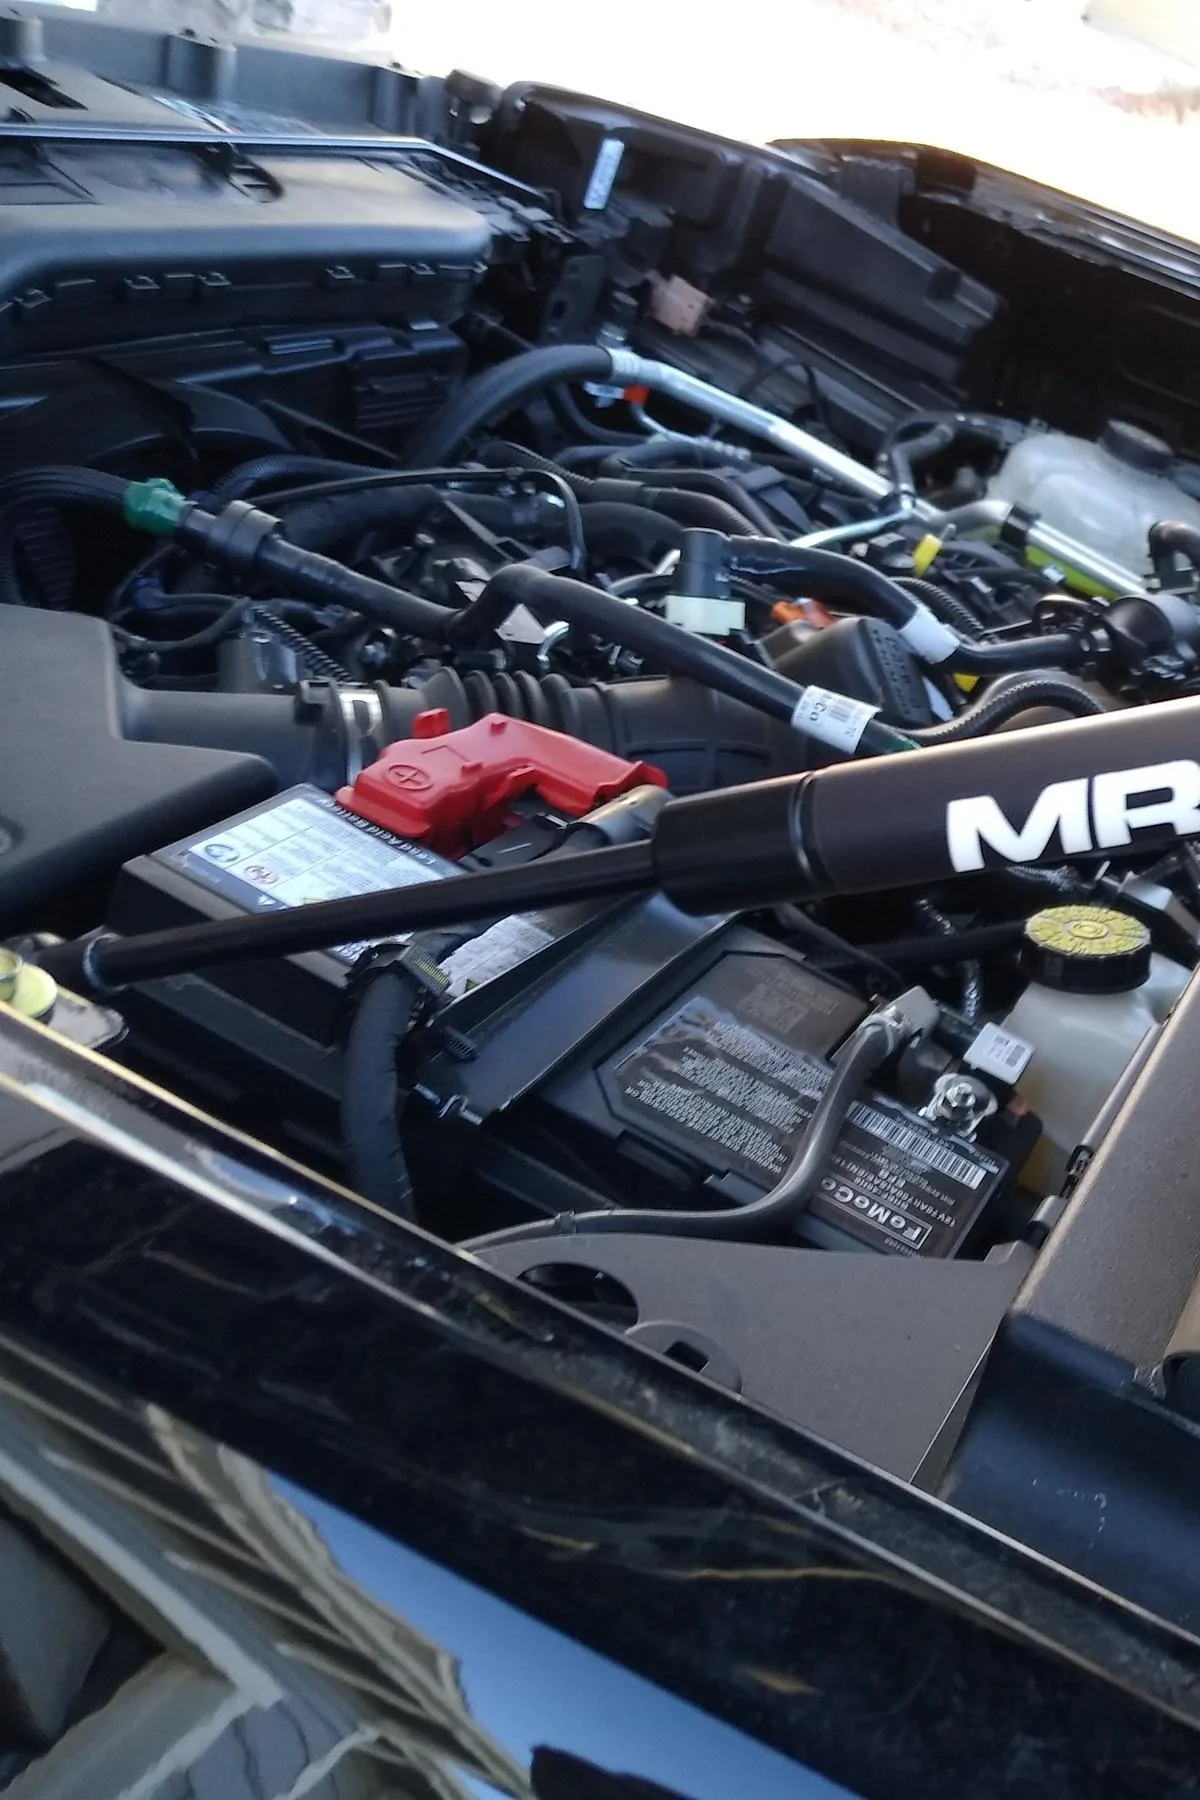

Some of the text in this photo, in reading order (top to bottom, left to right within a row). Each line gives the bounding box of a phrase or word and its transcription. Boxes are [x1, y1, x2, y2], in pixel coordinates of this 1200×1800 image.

[319, 799, 436, 866] Lead Acid Battery
[821, 1177, 922, 1241] FoMoCo
